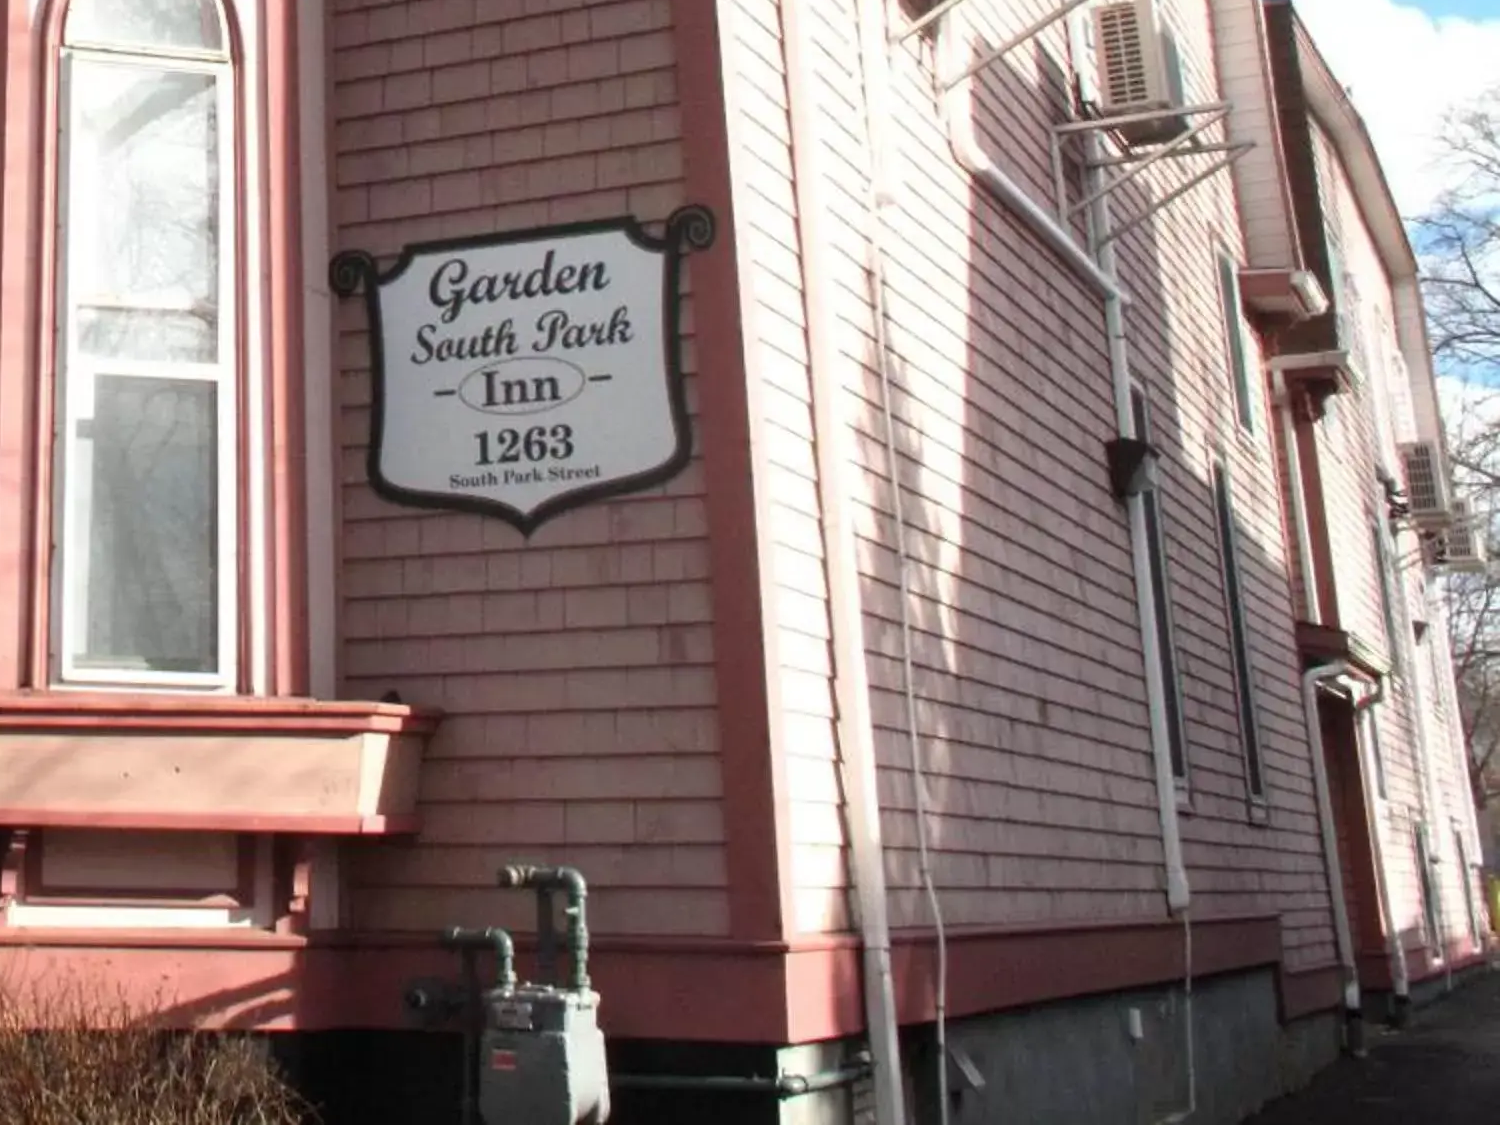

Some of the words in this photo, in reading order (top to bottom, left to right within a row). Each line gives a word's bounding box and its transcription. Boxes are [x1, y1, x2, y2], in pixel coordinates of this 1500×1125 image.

[429, 250, 611, 323] Garden
[411, 318, 519, 365] South
[532, 305, 635, 353] Park
[481, 371, 562, 407] Inn
[474, 424, 575, 465] 1263
[449, 472, 499, 489] South
[503, 469, 544, 485] Park
[547, 464, 601, 482] Street
